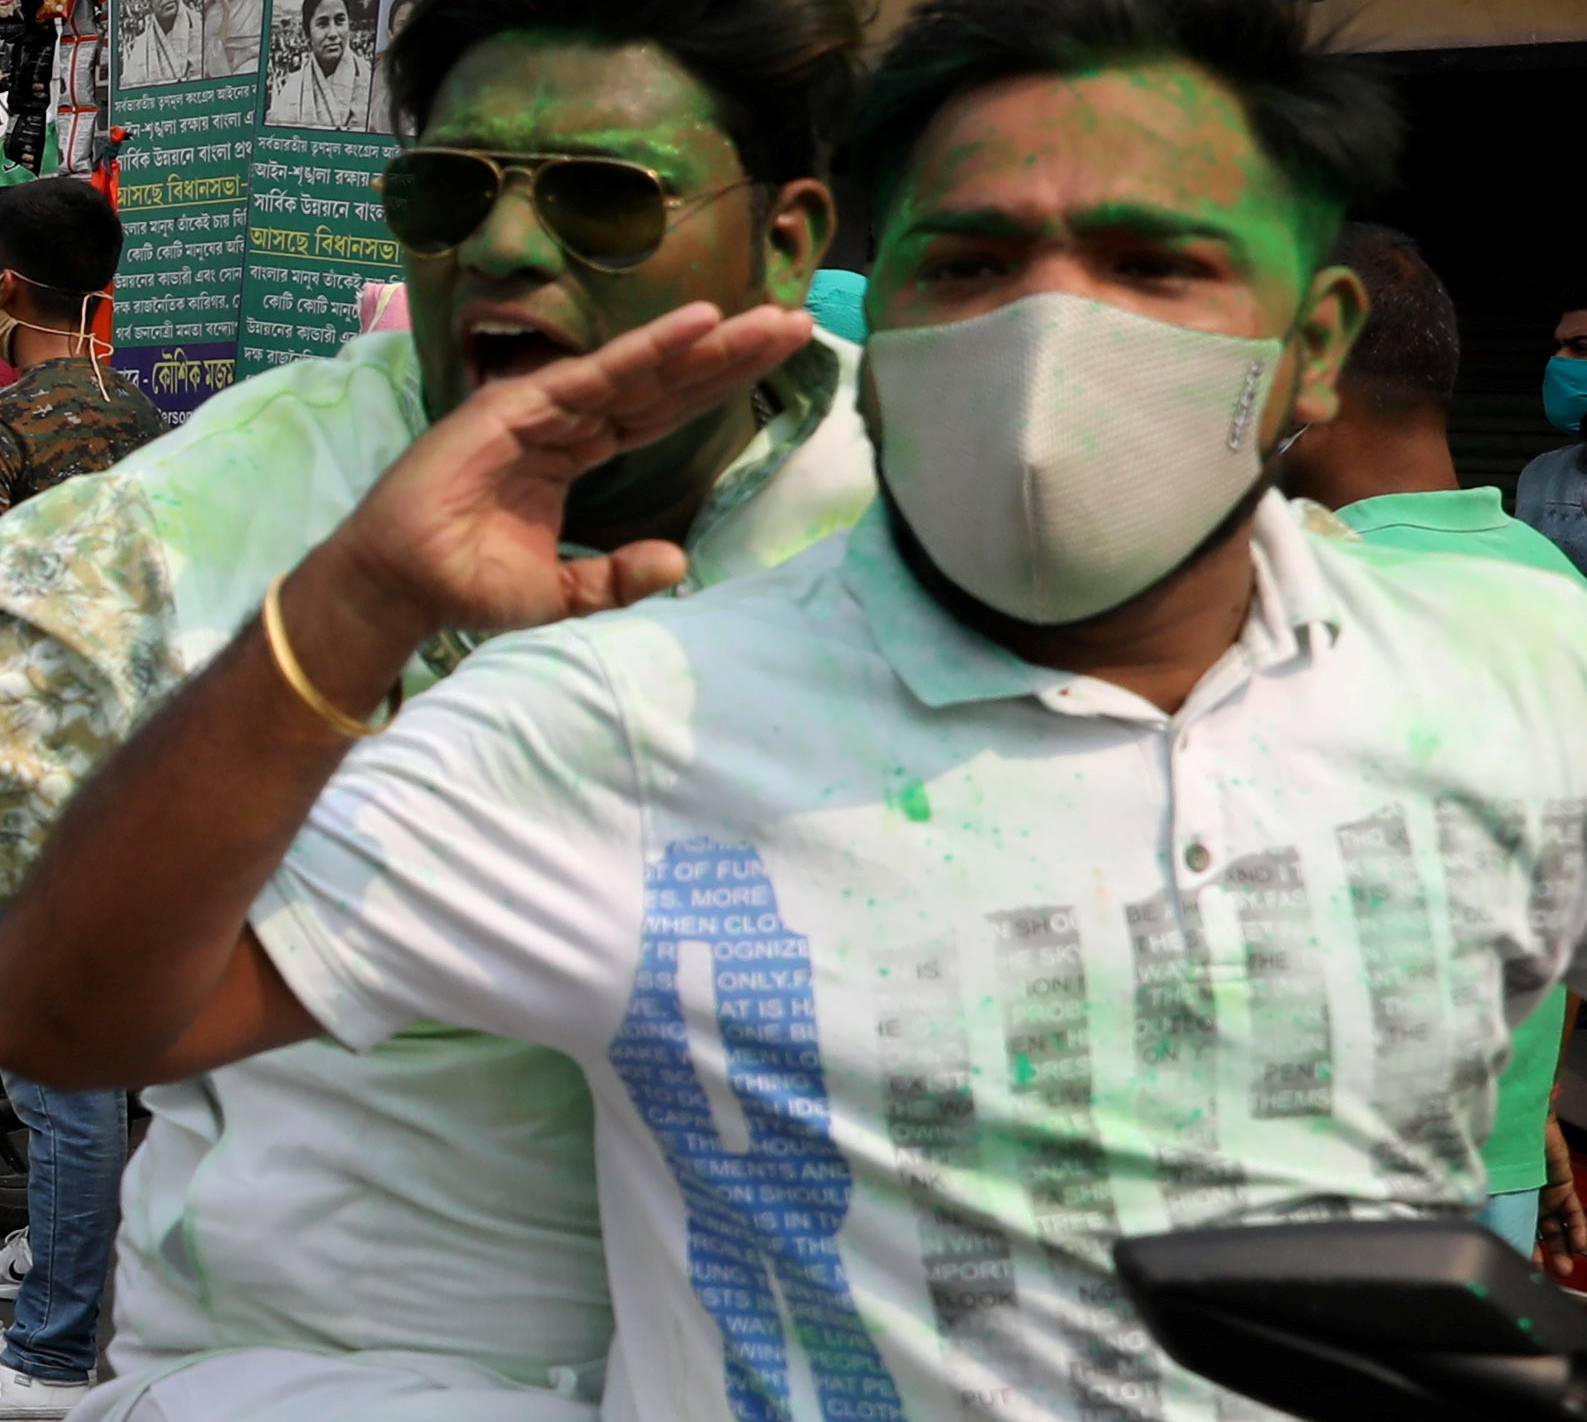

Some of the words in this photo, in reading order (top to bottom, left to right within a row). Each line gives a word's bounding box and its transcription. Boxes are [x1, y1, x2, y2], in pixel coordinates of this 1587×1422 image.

[253, 187, 298, 214] সার্বিক
[300, 192, 350, 219] উন্নয়নে
[250, 226, 310, 257] আসছে
[250, 265, 289, 283] বাংলার
[291, 269, 321, 290] মানুষ
[263, 290, 294, 312] কোটি
[297, 294, 329, 315] কোটি
[246, 317, 293, 339] উন্নয়নের
[691, 886, 769, 909] MORE
